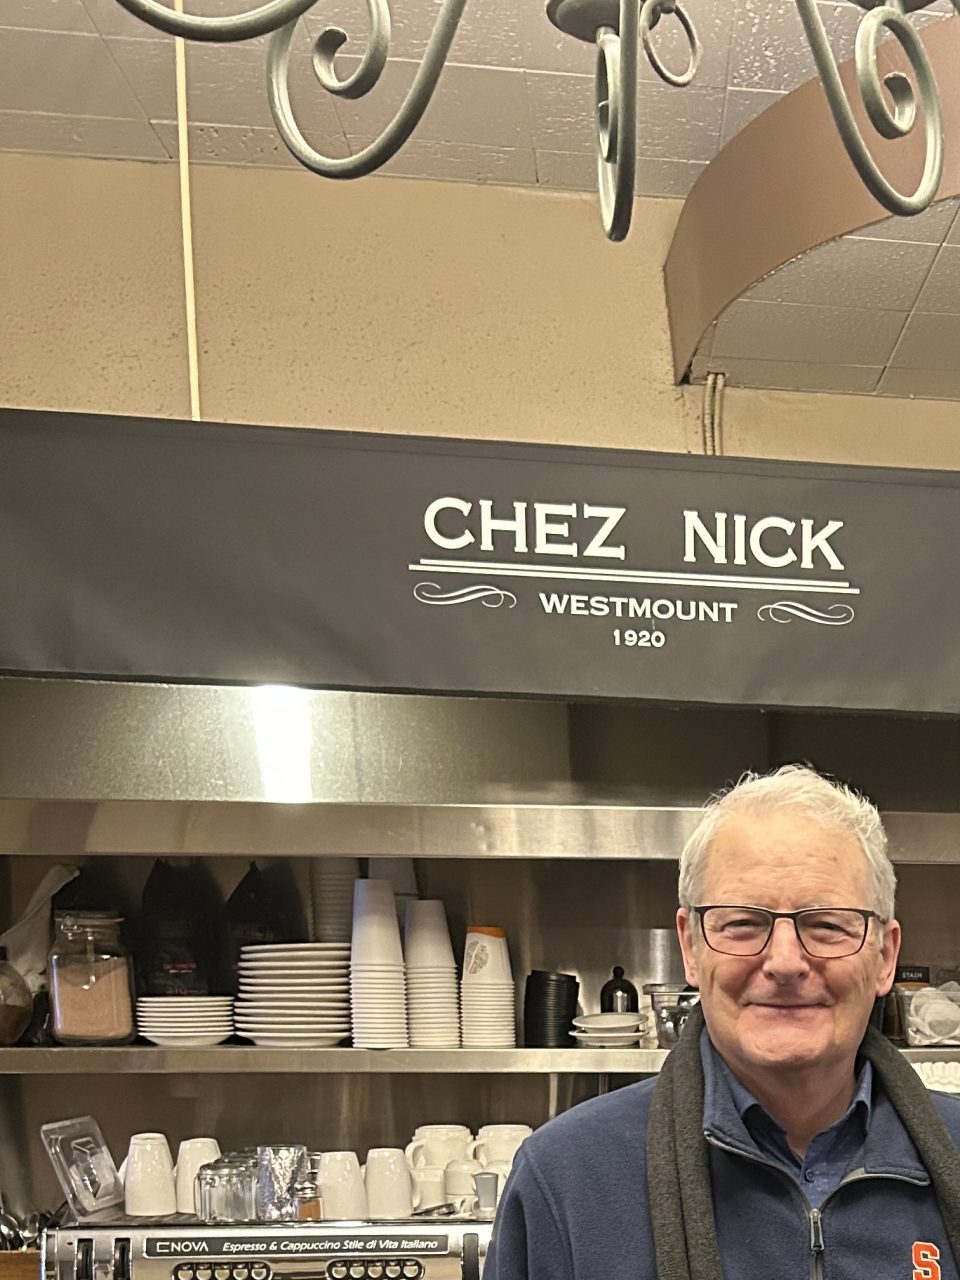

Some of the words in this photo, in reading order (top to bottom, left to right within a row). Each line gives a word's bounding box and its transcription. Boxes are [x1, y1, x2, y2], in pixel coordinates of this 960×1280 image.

[424, 497, 626, 561] CHEZ
[683, 511, 846, 572] NICK
[538, 593, 738, 623] WESTMOUNT
[613, 629, 666, 647] 1920
[222, 1242, 266, 1253] Espresso
[269, 1241, 277, 1251] &
[280, 1240, 341, 1252] Cappuccino
[343, 1240, 363, 1250] Stile
[366, 1239, 376, 1249] di
[380, 1239, 398, 1249] Vita
[401, 1239, 438, 1249] Italiano
